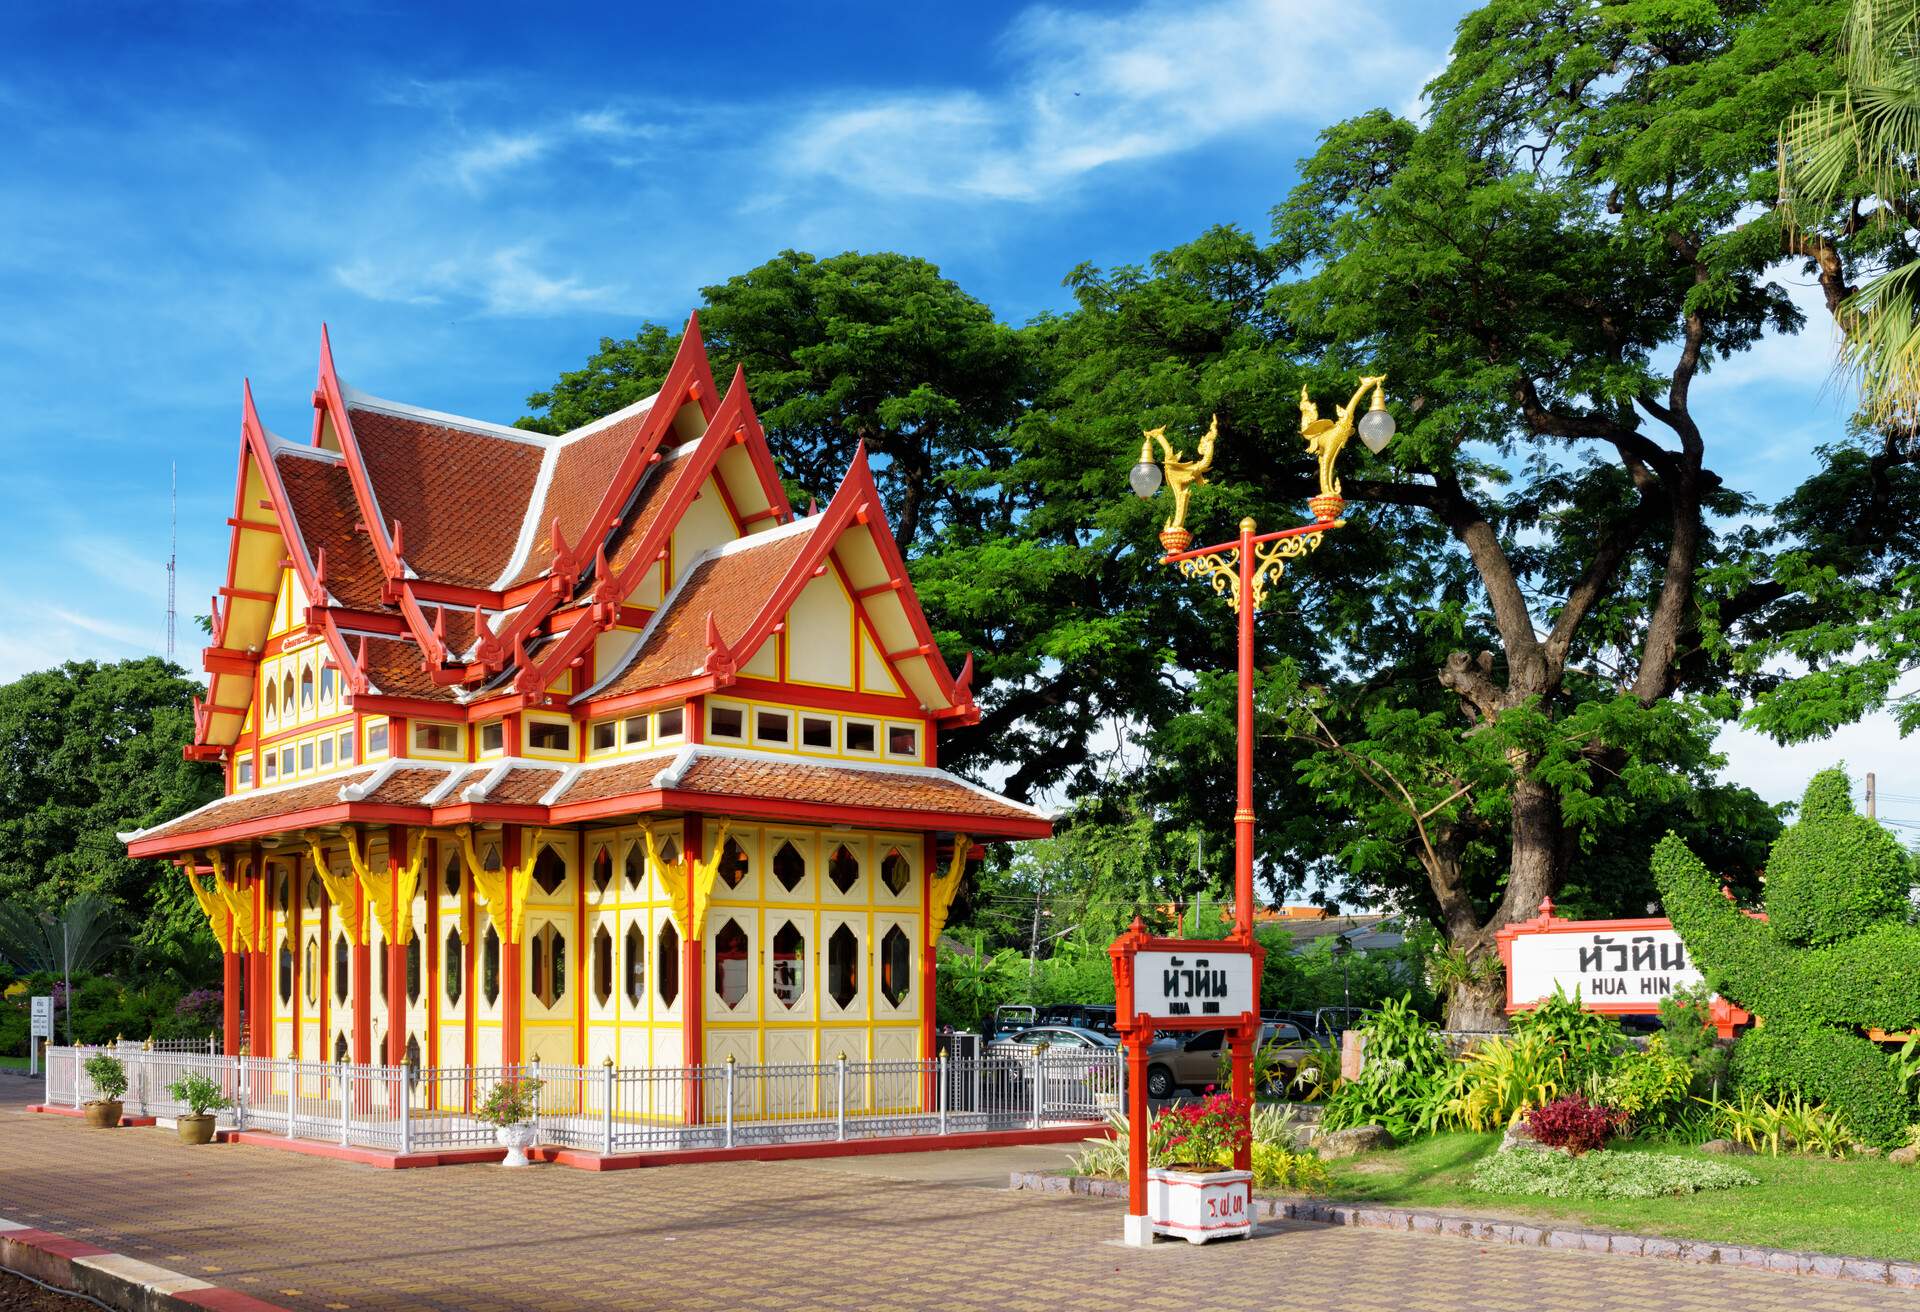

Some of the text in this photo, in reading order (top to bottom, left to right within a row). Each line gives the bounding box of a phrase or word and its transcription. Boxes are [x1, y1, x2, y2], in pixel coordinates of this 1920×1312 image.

[1579, 934, 1686, 973] หัวหิน
[1163, 955, 1228, 998] หัวหิน
[1592, 976, 1671, 995] HUA HIN
[1169, 1002, 1191, 1015] HUA
